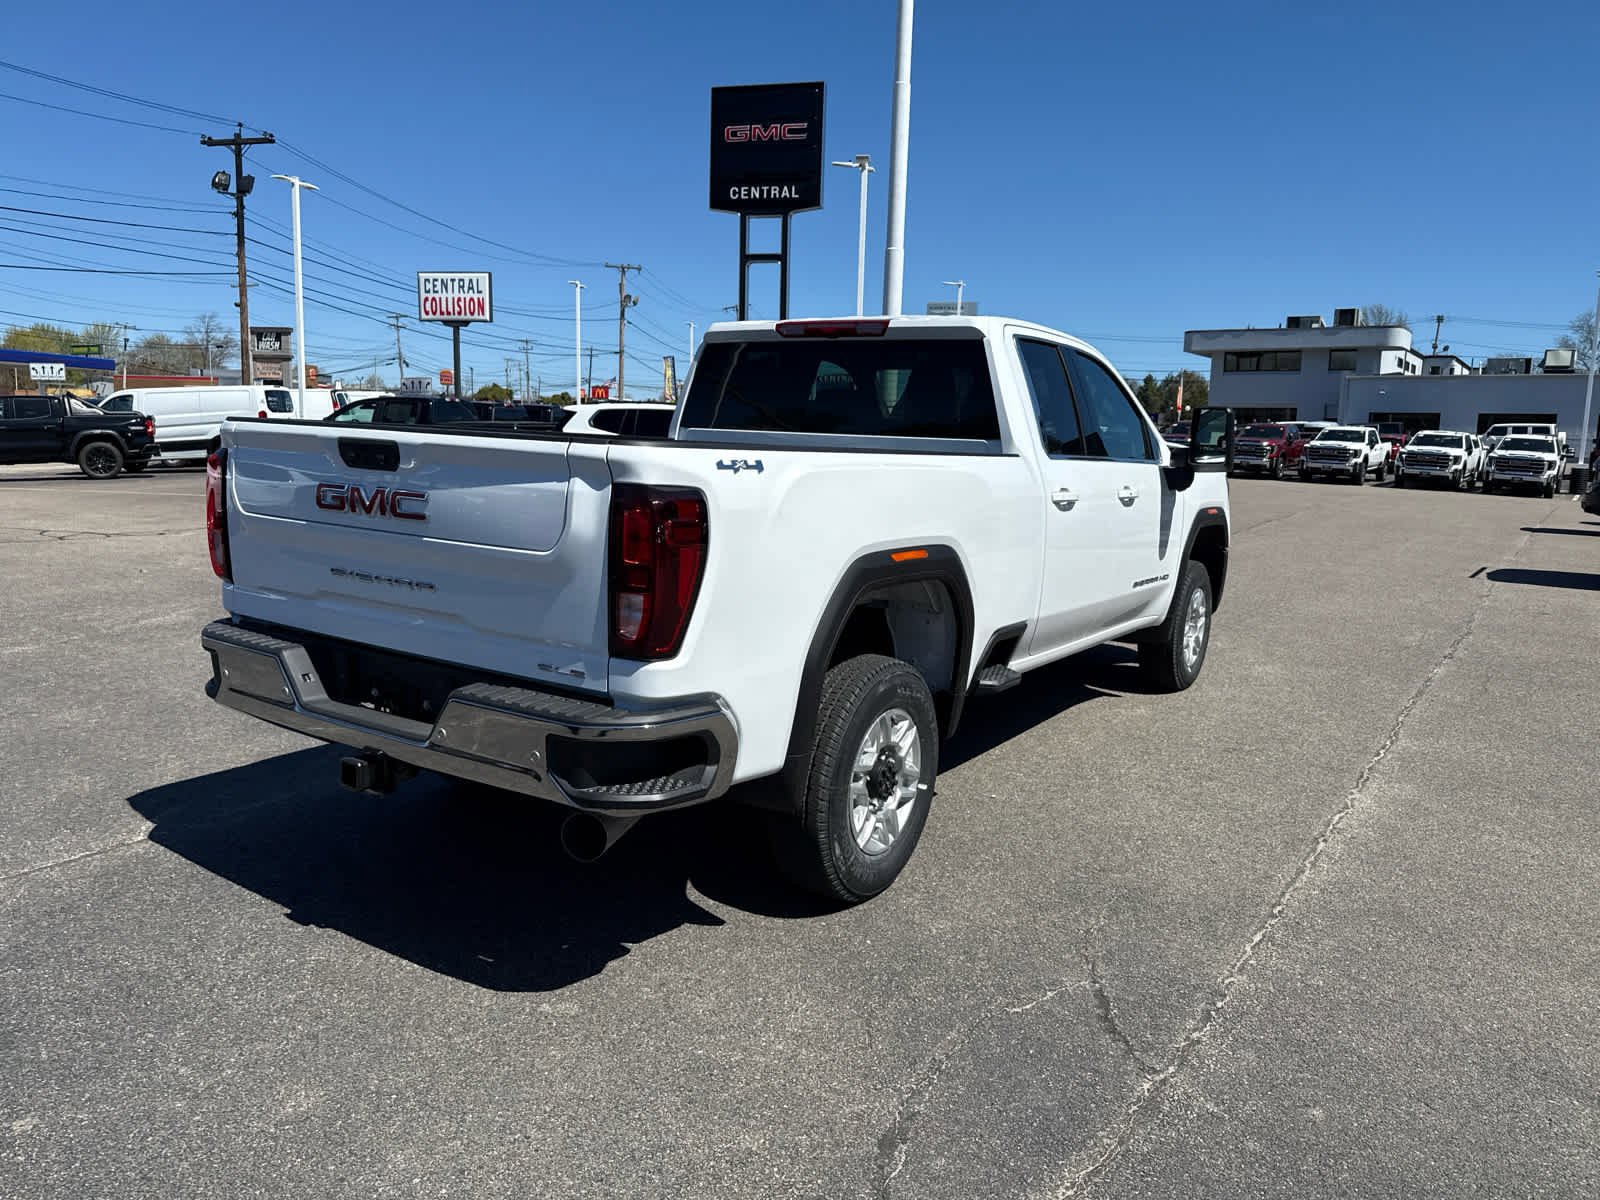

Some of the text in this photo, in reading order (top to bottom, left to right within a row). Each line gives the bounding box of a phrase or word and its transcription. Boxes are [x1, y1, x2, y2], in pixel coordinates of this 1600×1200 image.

[724, 122, 808, 143] GMC
[729, 185, 800, 200] CENTRAL
[423, 278, 484, 294] CENTRAL
[423, 296, 485, 317] COLLISION
[258, 340, 281, 351] WASH
[315, 482, 430, 521] GMC
[329, 567, 438, 593] SIERRA
